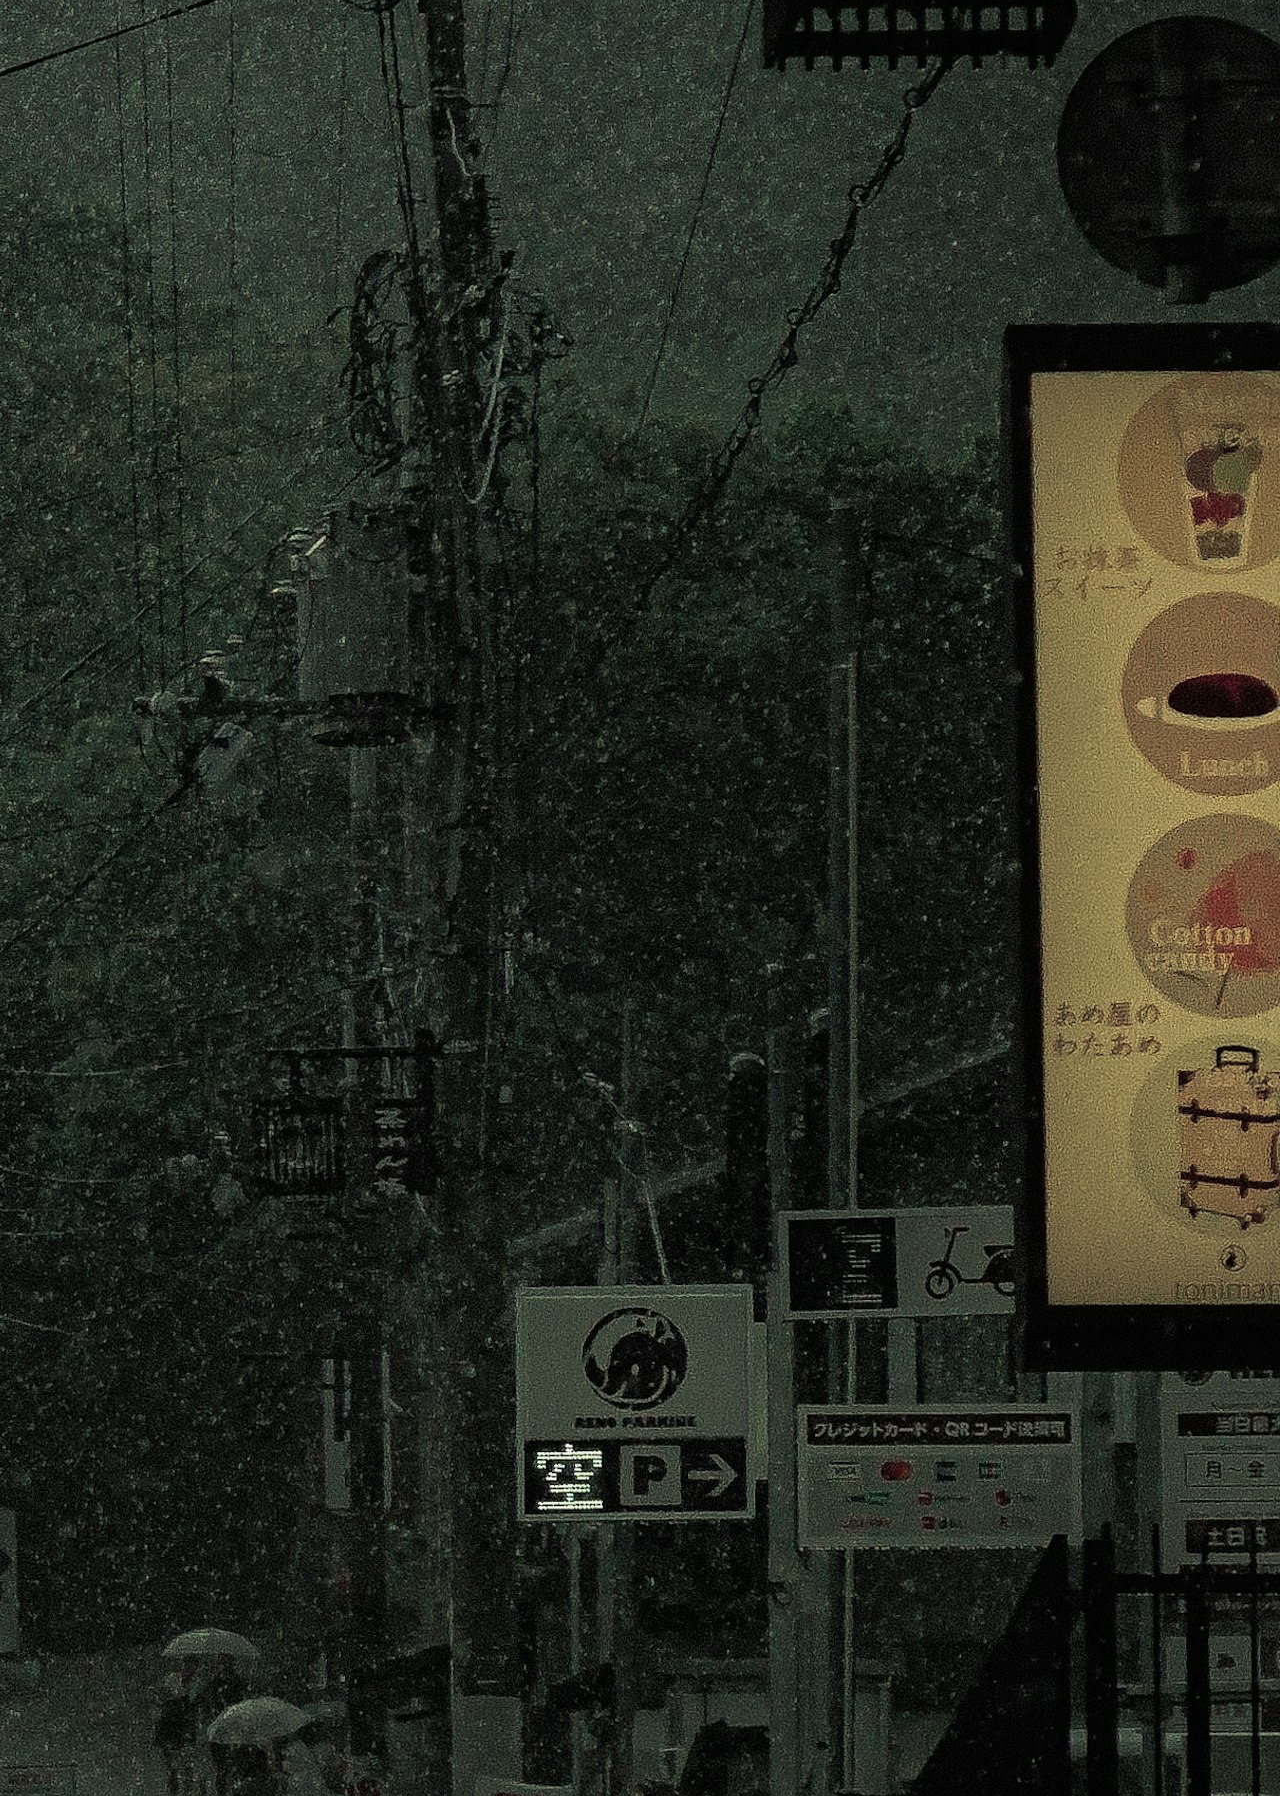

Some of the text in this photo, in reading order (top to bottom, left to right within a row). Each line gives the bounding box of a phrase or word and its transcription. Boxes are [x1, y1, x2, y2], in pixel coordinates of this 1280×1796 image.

[1178, 750, 1270, 778] Lunch
[1149, 917, 1253, 948] Cotton
[1144, 943, 1236, 975] candy
[1053, 1002, 1162, 1026] あめ屋の
[1051, 1033, 1163, 1058] わたあめ
[536, 1442, 605, 1511] 空
[632, 1455, 669, 1497] P
